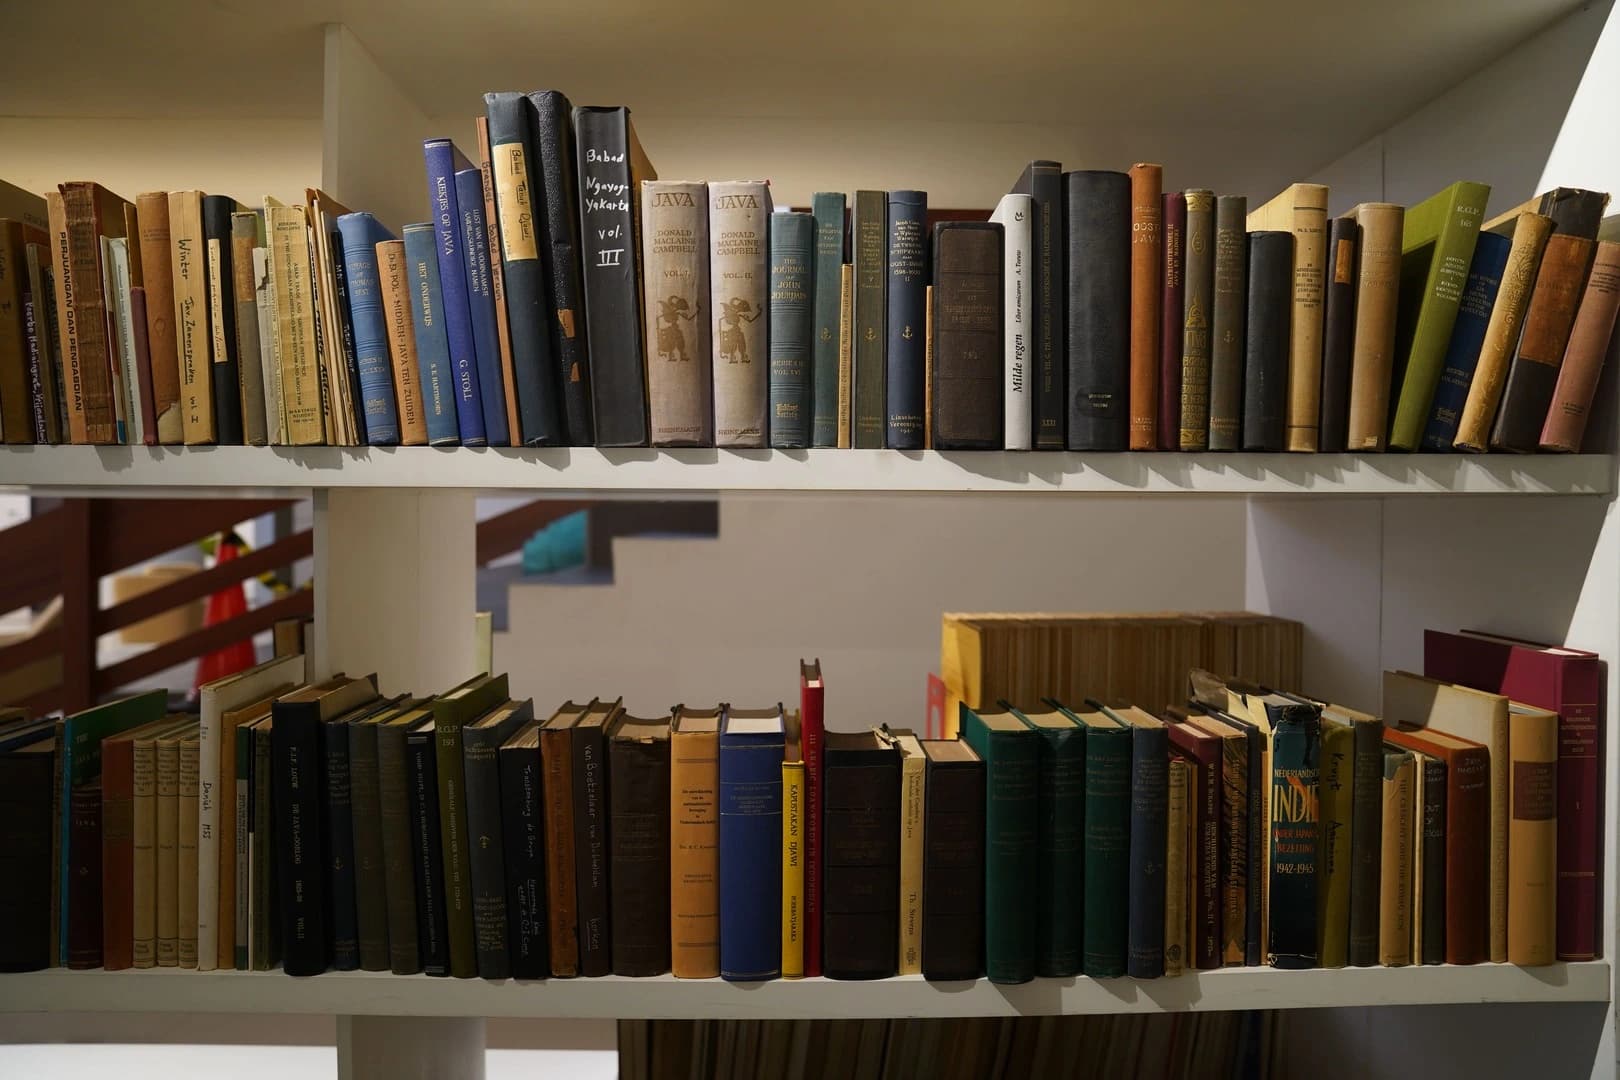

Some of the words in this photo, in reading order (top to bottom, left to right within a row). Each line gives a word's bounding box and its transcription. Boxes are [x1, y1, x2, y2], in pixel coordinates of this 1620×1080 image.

[586, 149, 624, 164] Babad
[652, 192, 696, 208] JAVA
[716, 195, 759, 209] JAVA
[442, 230, 454, 255] JAVA
[475, 227, 483, 240] VAN
[656, 229, 692, 237] DONALD
[178, 238, 192, 280] Winter
[596, 248, 625, 267] III
[653, 245, 697, 254] CAMPBELL
[717, 247, 761, 256] CAMPBELL
[60, 232, 73, 308] PERJUANGAN
[418, 262, 428, 278] HET
[391, 275, 400, 291] POL
[777, 281, 801, 289] JOHN
[67, 311, 76, 335] DAN
[1014, 334, 1025, 361] regen
[70, 338, 82, 412] PENGABDIAN
[401, 367, 411, 386] TEN
[1012, 363, 1023, 393] Milde
[461, 371, 473, 402] STOLL
[404, 389, 416, 425] ZUIDEN
[790, 784, 798, 836] KAPUSTAKAN
[789, 842, 798, 868] DJAWI
[1276, 862, 1315, 874] 1942-1945
